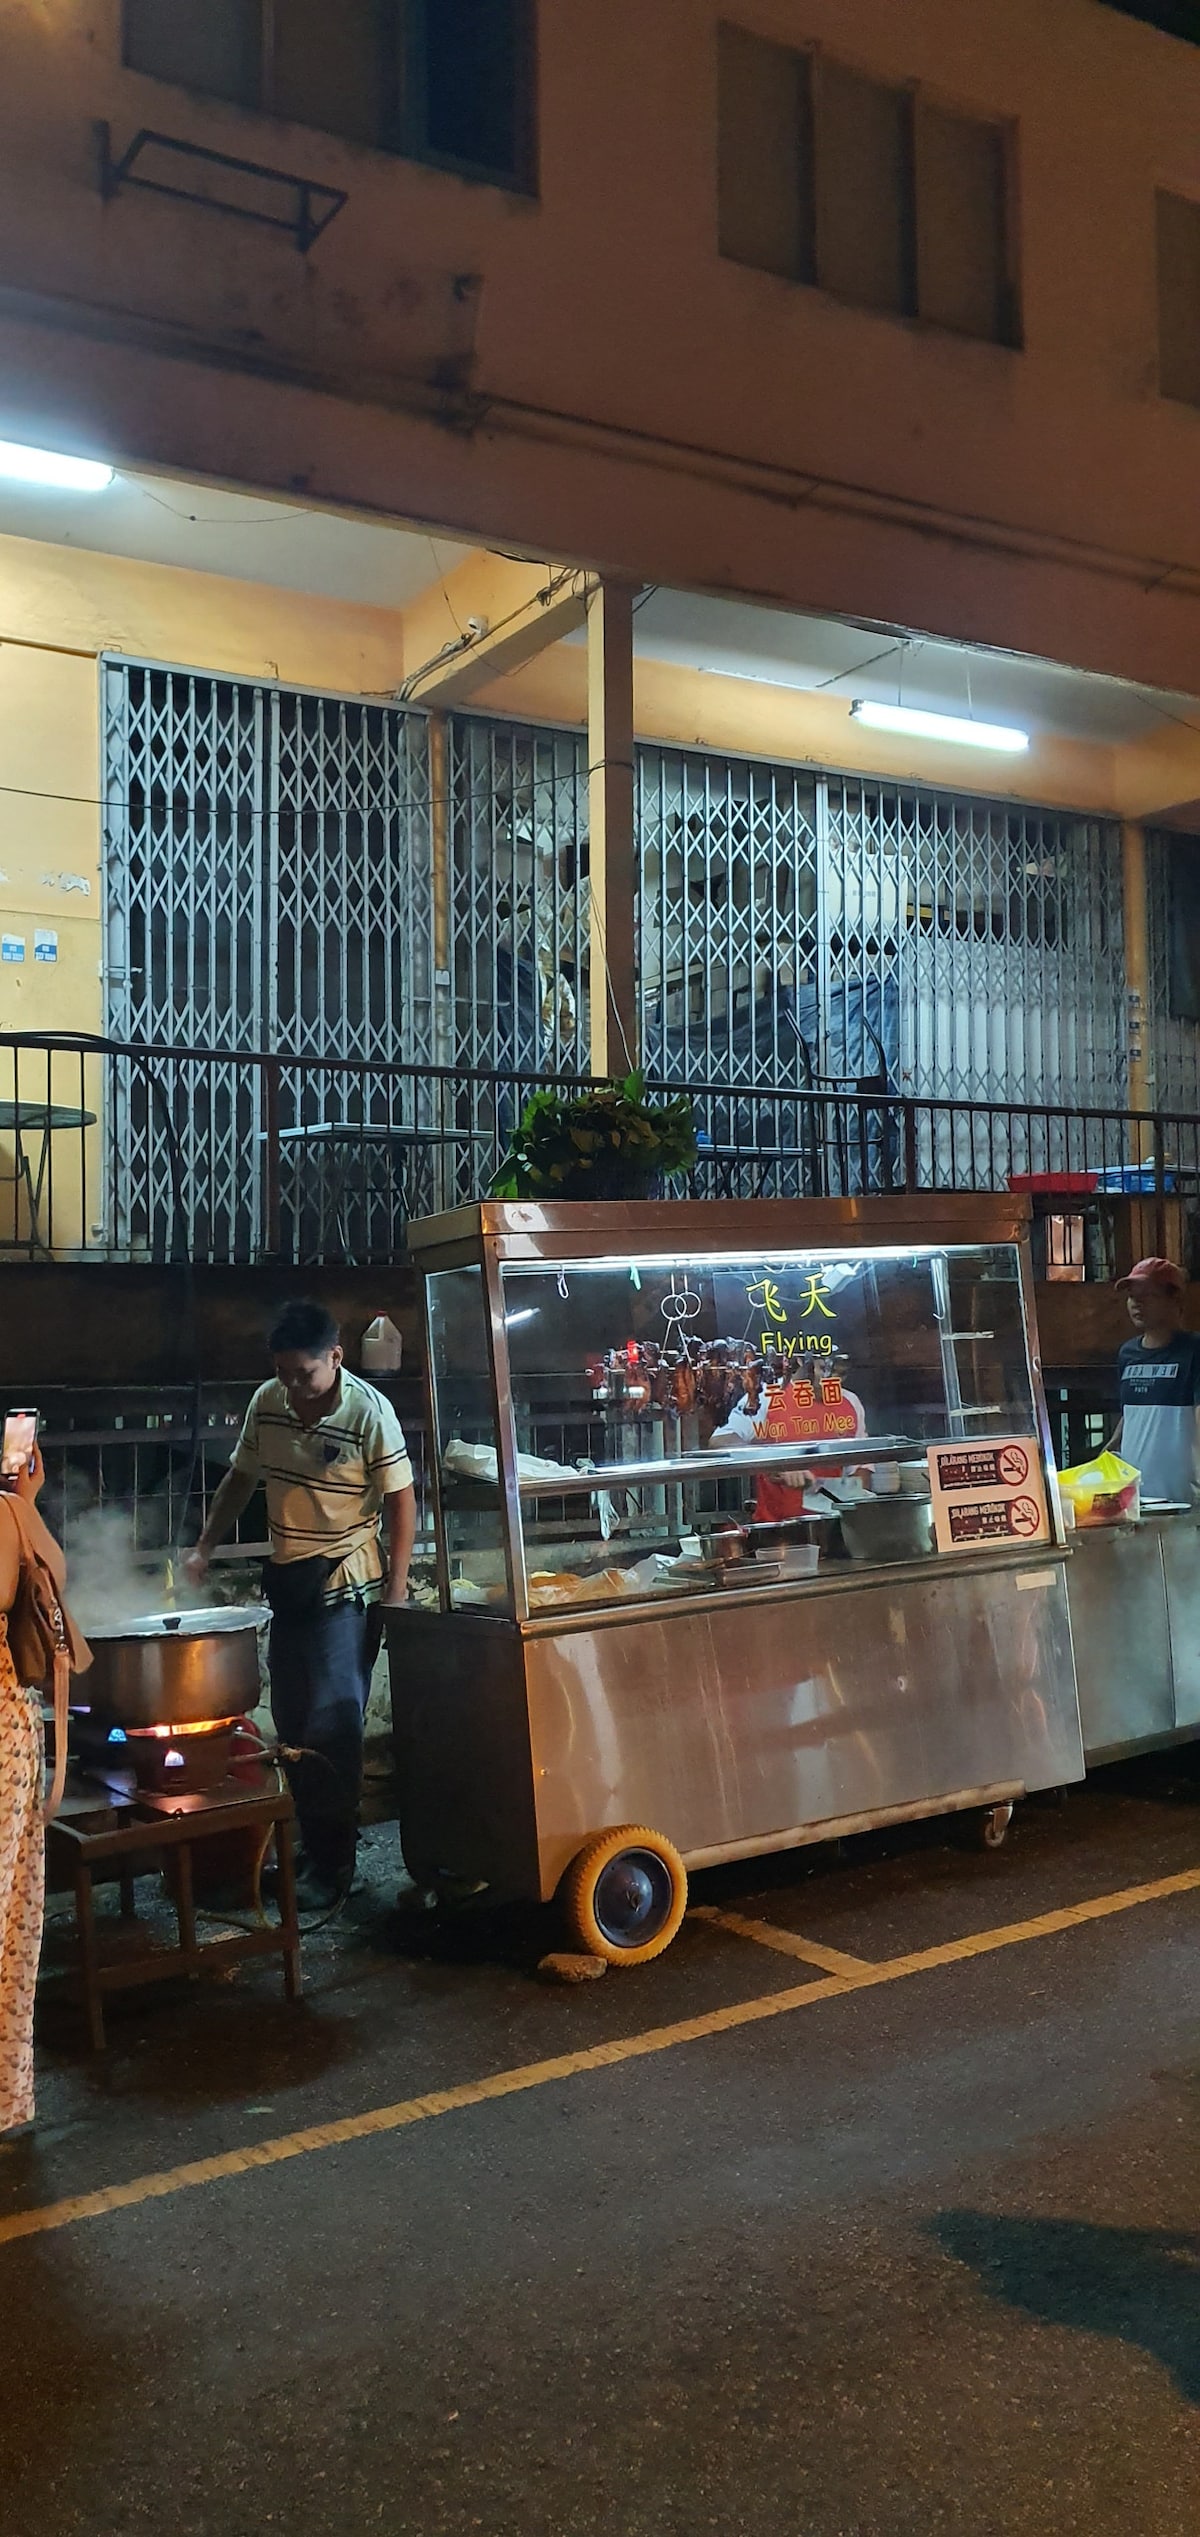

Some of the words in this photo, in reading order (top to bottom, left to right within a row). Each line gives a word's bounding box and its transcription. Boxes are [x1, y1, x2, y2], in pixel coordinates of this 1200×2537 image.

[745, 1272, 838, 1323] 飞天
[760, 1331, 833, 1358] Flying
[765, 1376, 843, 1413] 云吞面
[752, 1419, 788, 1440] Wan
[823, 1412, 856, 1432] Mee
